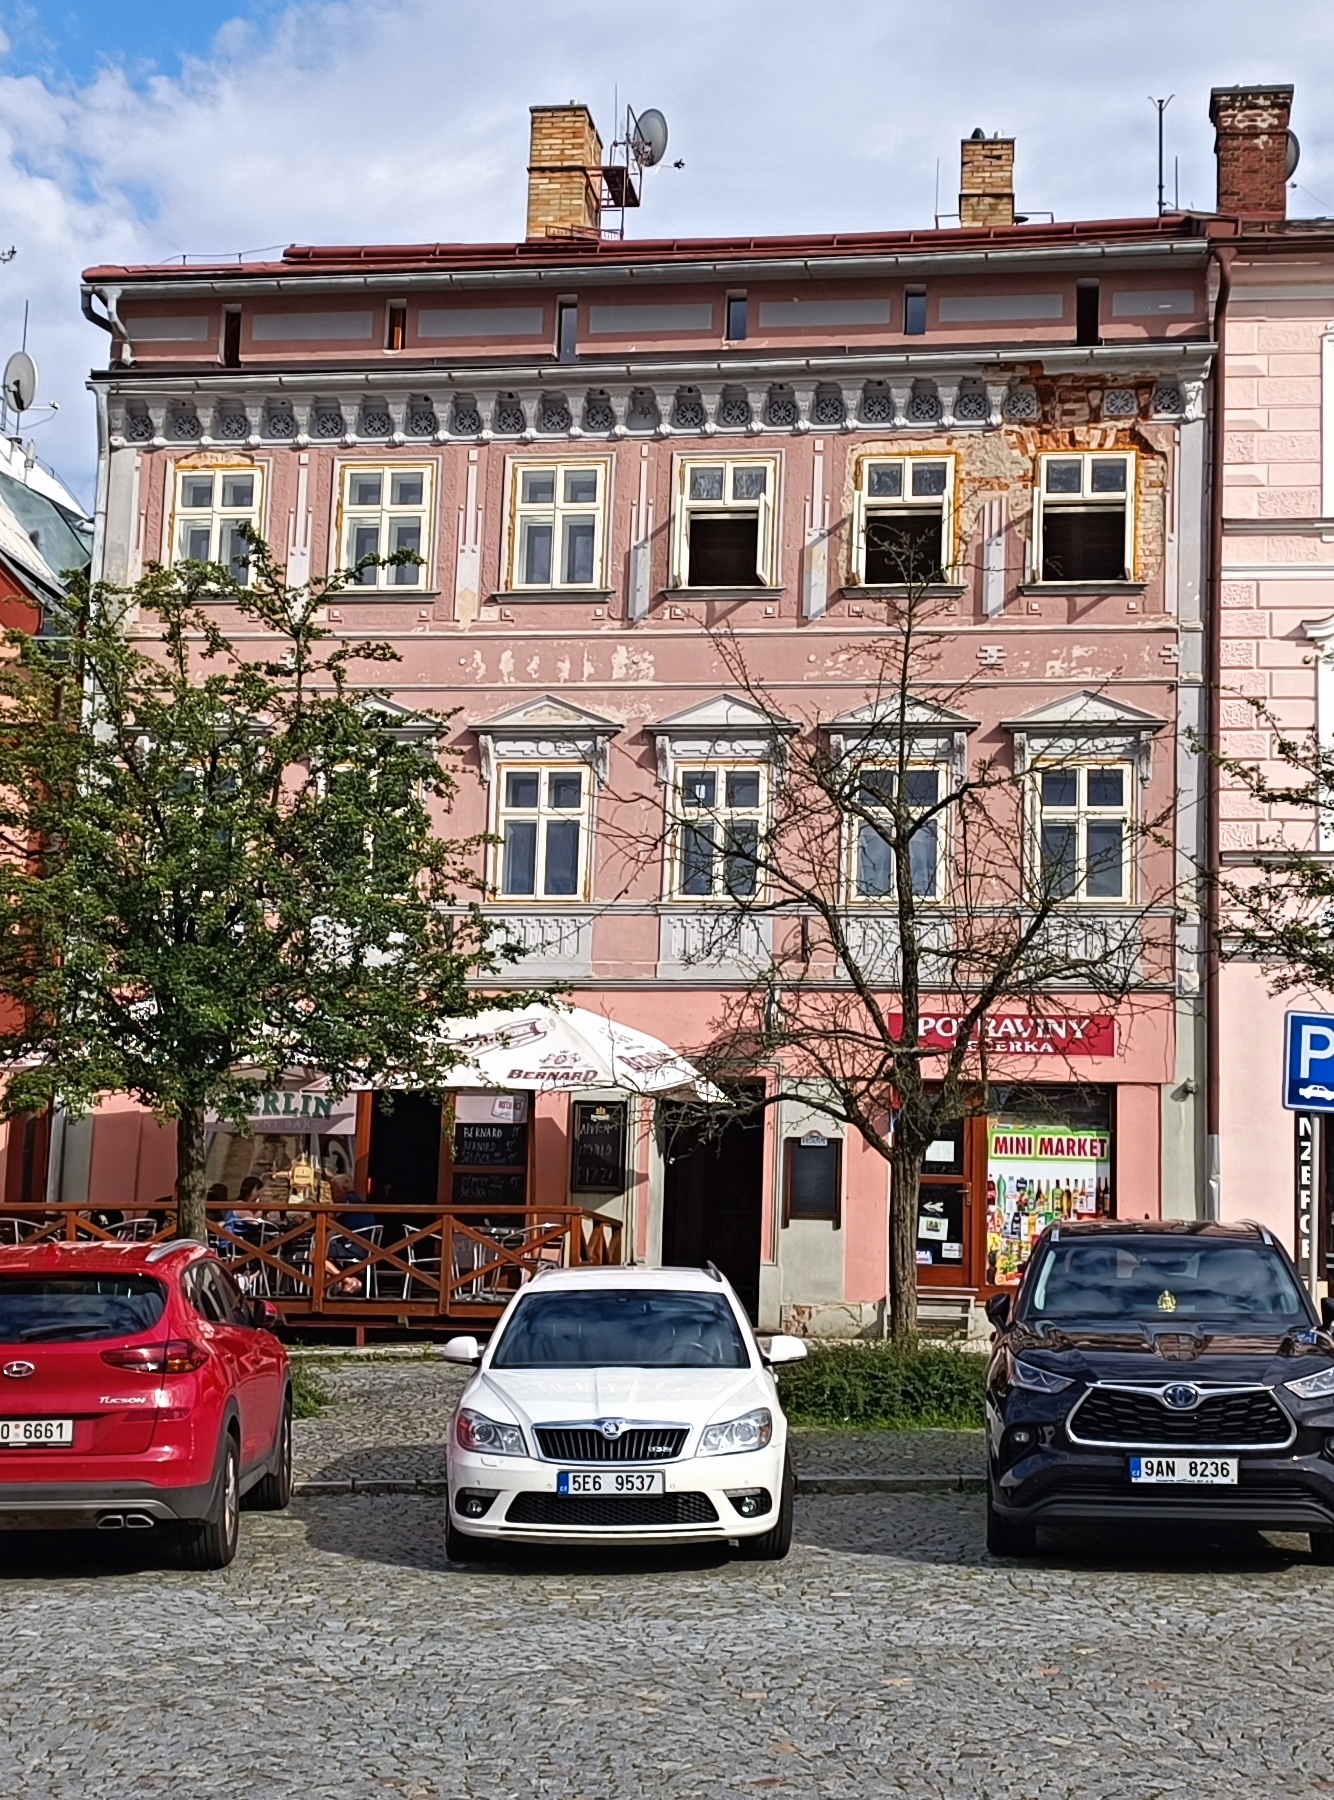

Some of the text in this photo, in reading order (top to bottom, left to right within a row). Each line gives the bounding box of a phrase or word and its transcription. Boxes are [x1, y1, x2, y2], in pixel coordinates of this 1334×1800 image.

[951, 1037, 1054, 1053] EERKA
[507, 1069, 598, 1082] BERNARD
[463, 1126, 503, 1138] BERNARD
[994, 1136, 1107, 1158] MINI MARKET
[98, 1396, 146, 1404] TUCSON
[23, 1422, 64, 1439] 6661
[1144, 1460, 1176, 1477] 9AN
[1188, 1461, 1230, 1478] 8236
[572, 1474, 602, 1492] 5E6
[615, 1474, 655, 1492] 9537
